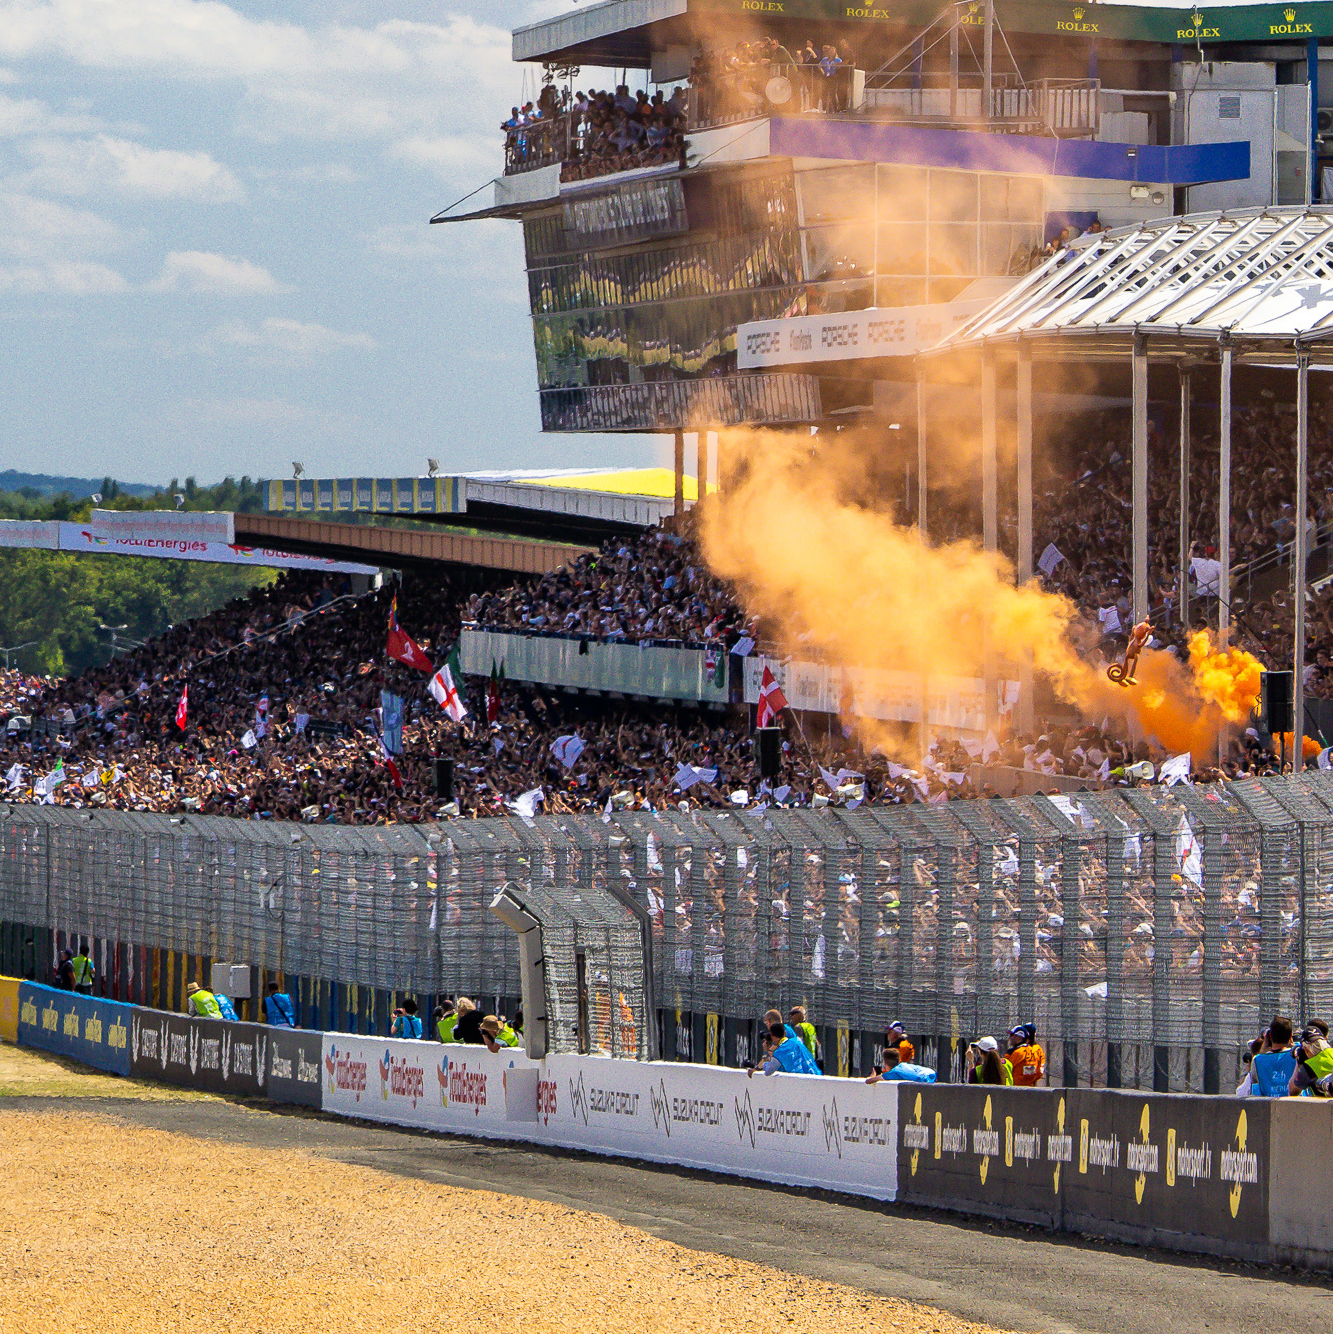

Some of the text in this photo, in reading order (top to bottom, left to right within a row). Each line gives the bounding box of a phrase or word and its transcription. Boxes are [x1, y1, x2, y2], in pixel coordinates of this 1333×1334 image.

[742, 0, 785, 12] ROLEX
[846, 7, 889, 19] ROLEX
[1056, 21, 1099, 33] ROLEX
[1177, 27, 1221, 39] ROLEX
[1270, 23, 1313, 34] ROLEX
